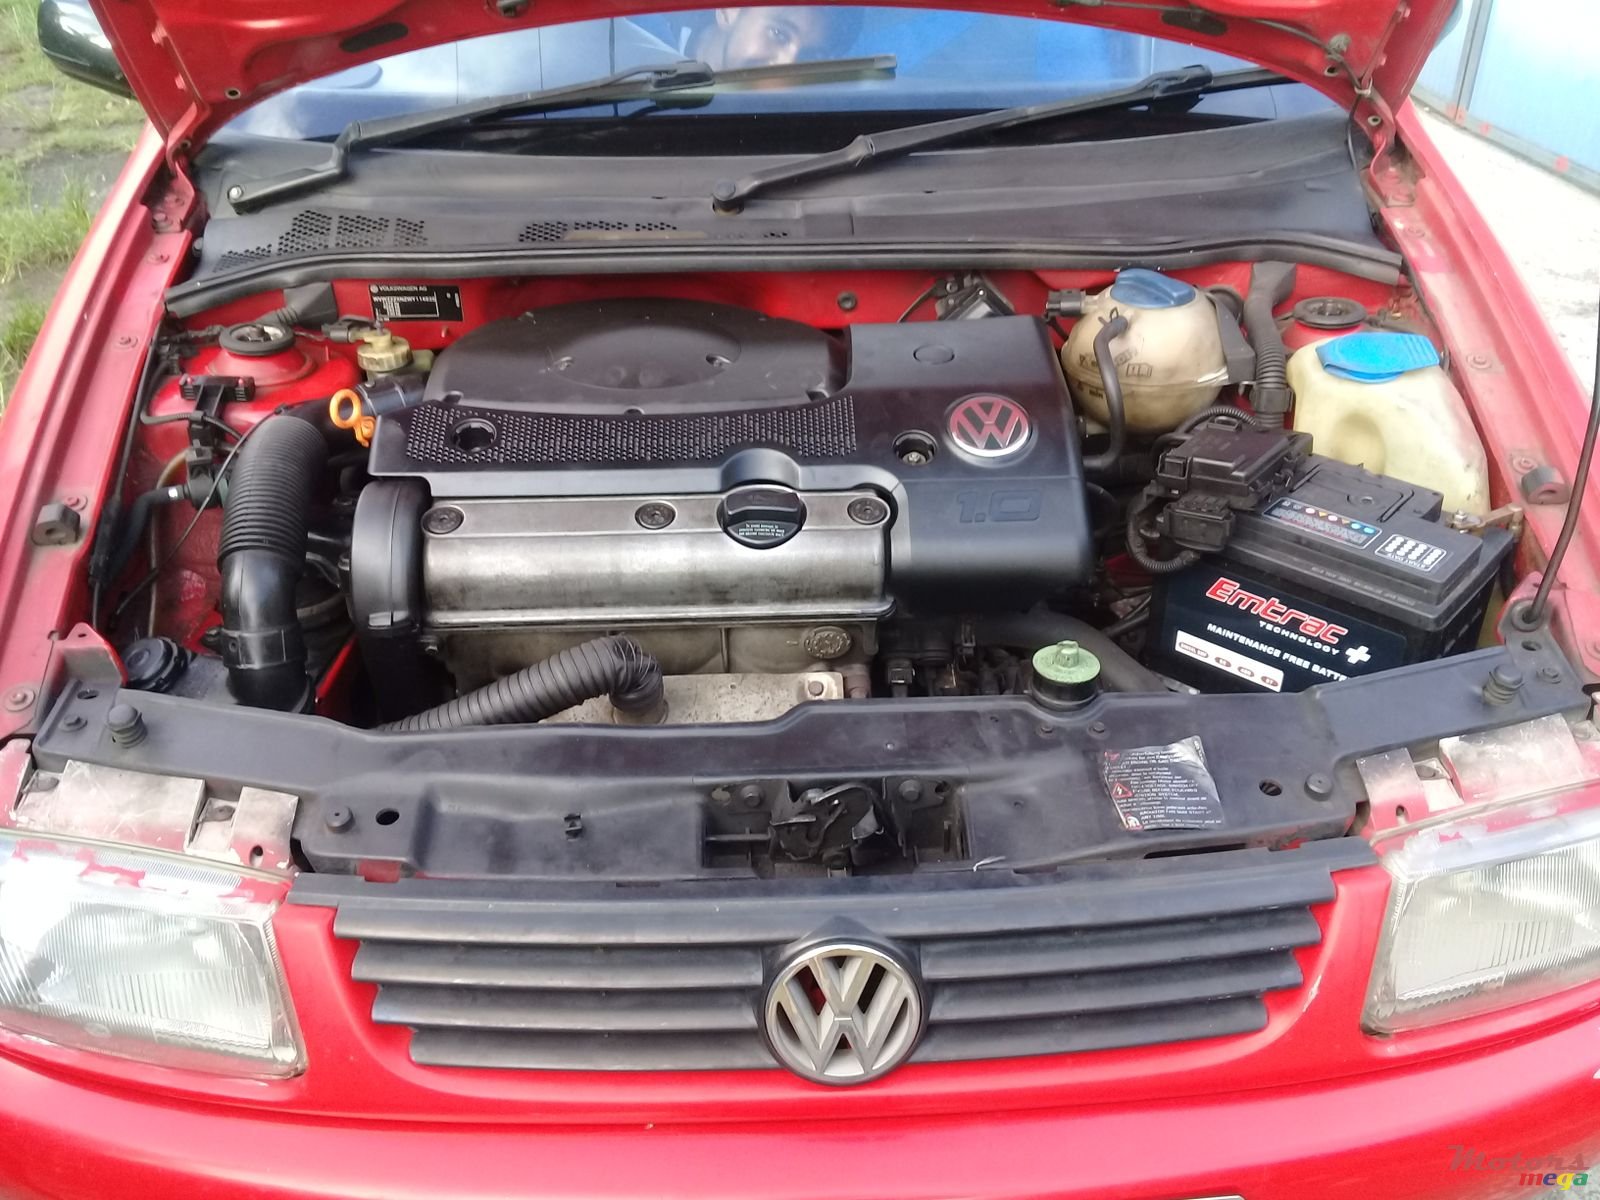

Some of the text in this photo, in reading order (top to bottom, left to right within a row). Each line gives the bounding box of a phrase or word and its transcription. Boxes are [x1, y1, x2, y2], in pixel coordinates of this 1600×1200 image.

[957, 489, 1041, 524] 1.0
[1205, 577, 1348, 645] Emtrac
[1206, 623, 1281, 658] MAINTENANCE
[1282, 650, 1311, 670] FREE
[1259, 620, 1340, 656] TECHNOLOGY
